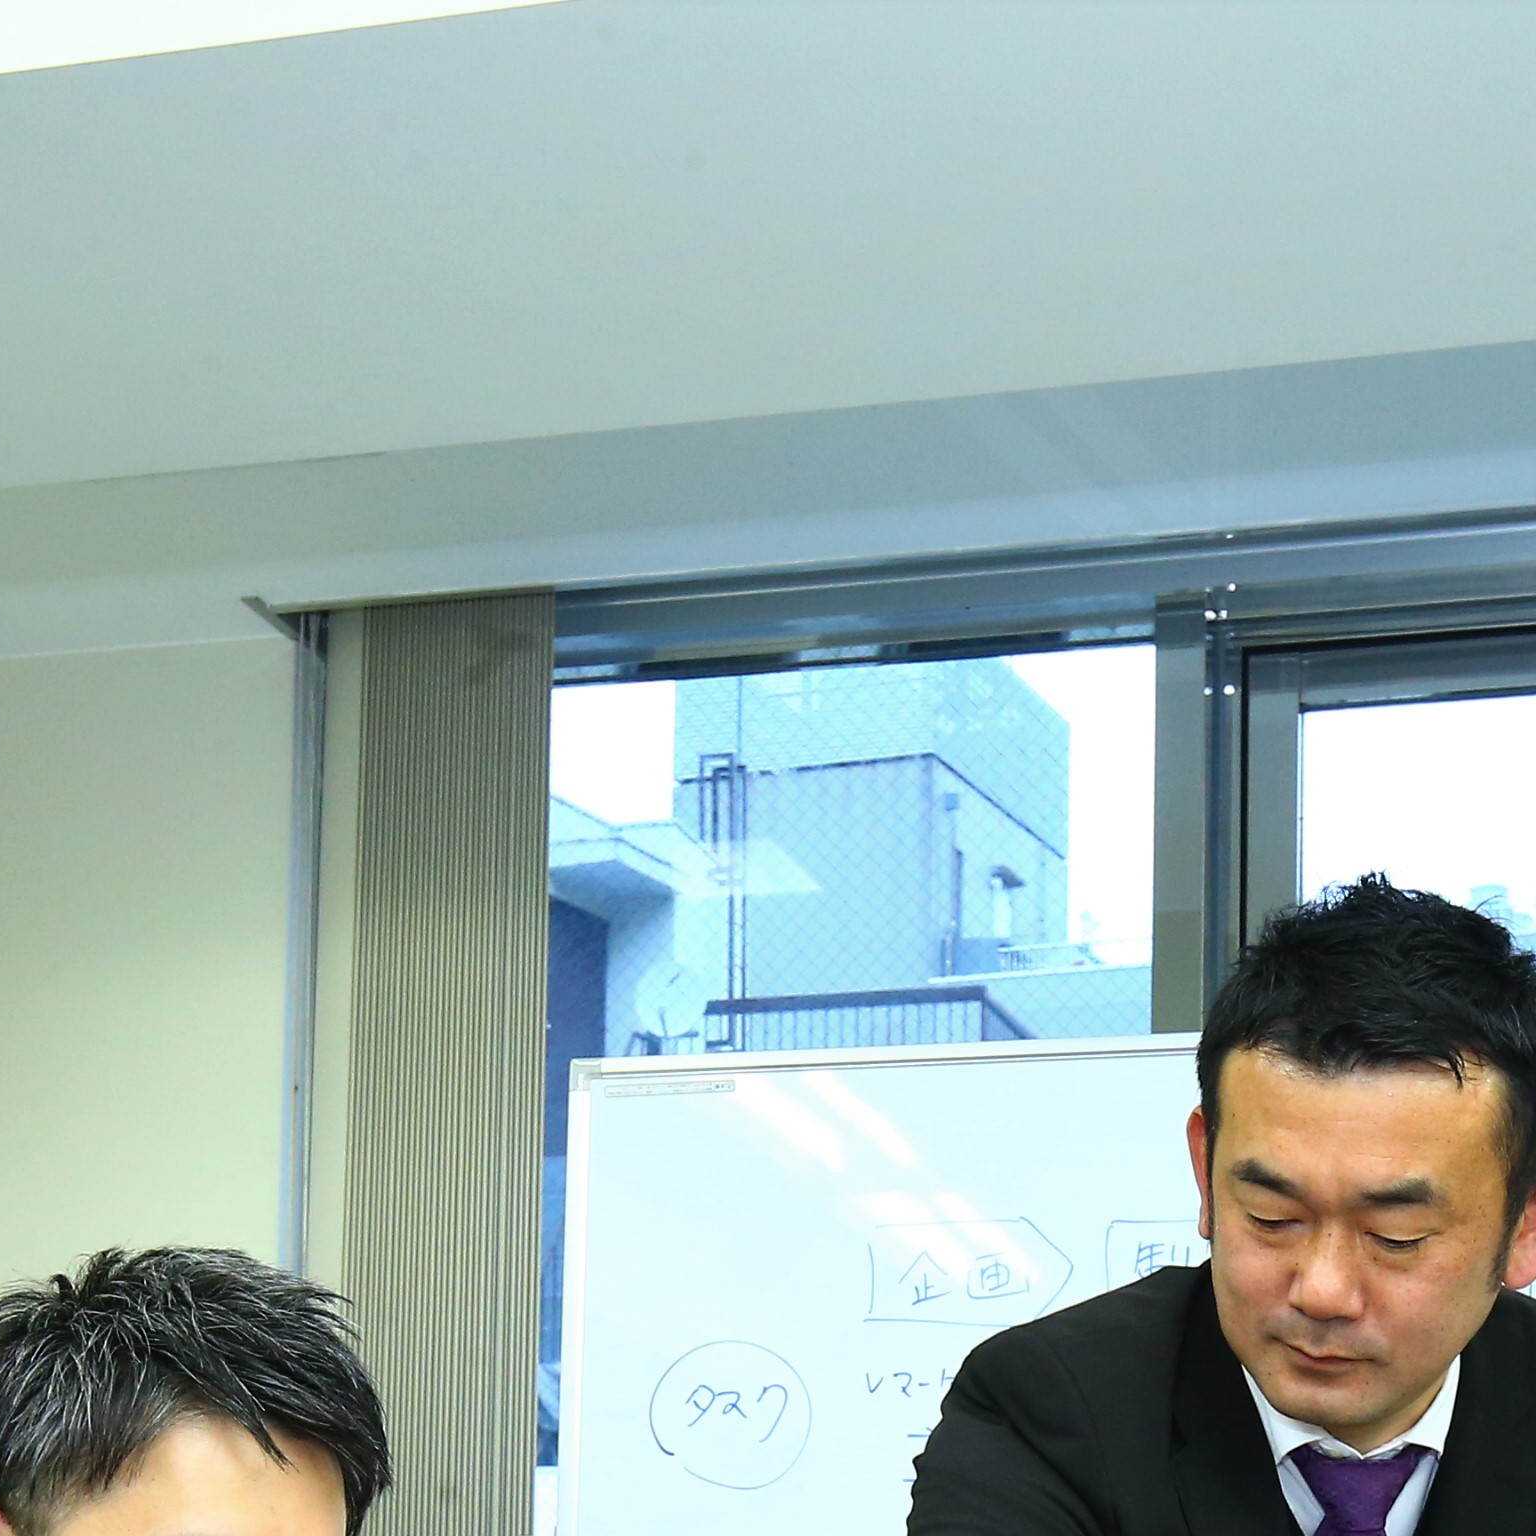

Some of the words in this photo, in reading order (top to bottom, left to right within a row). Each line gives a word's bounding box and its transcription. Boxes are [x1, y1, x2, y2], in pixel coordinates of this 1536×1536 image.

[897, 1249, 1031, 1306] 企画
[685, 1383, 789, 1444] タスク
